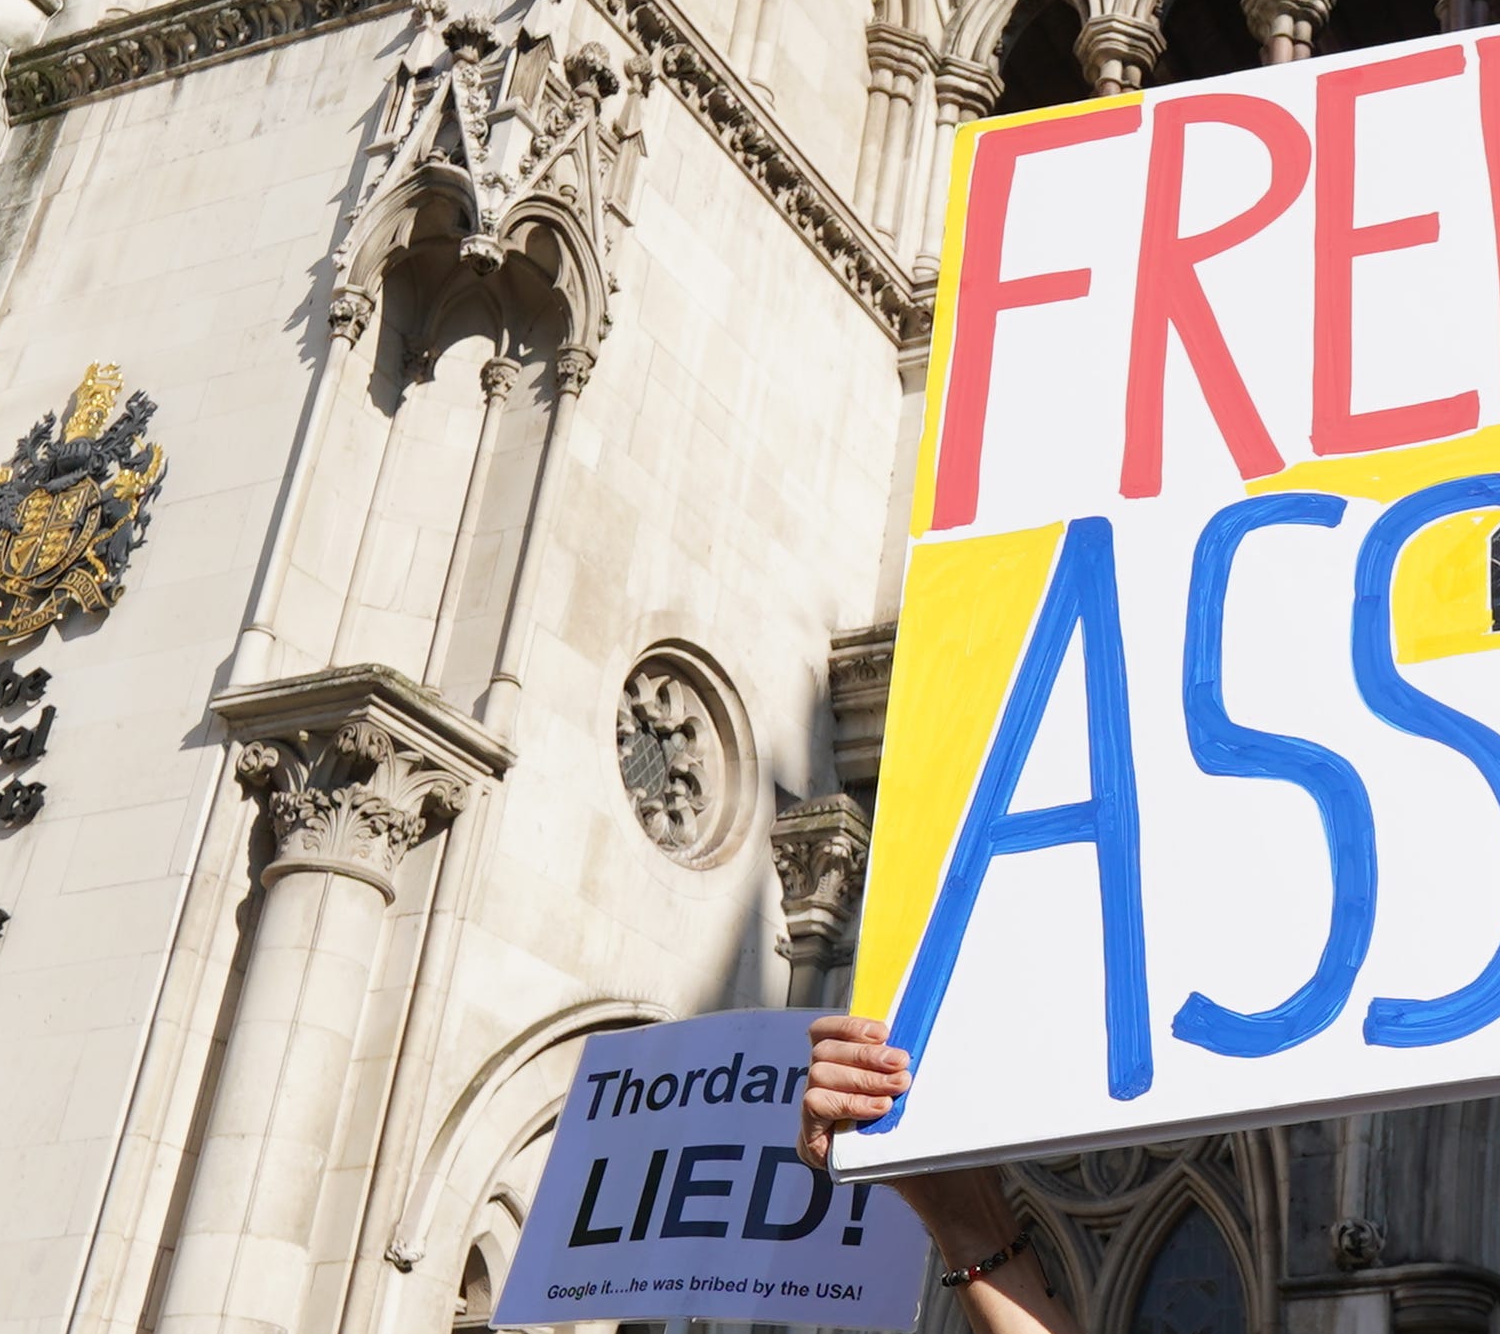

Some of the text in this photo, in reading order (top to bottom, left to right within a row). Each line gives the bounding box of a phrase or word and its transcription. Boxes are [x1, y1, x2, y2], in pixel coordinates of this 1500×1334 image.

[567, 1144, 873, 1248] LIED!
[547, 1279, 597, 1301] Google
[652, 1275, 685, 1292] was
[689, 1275, 748, 1293] bribed
[752, 1278, 776, 1298] by
[780, 1279, 810, 1298] the
[814, 1281, 864, 1302] USA!
